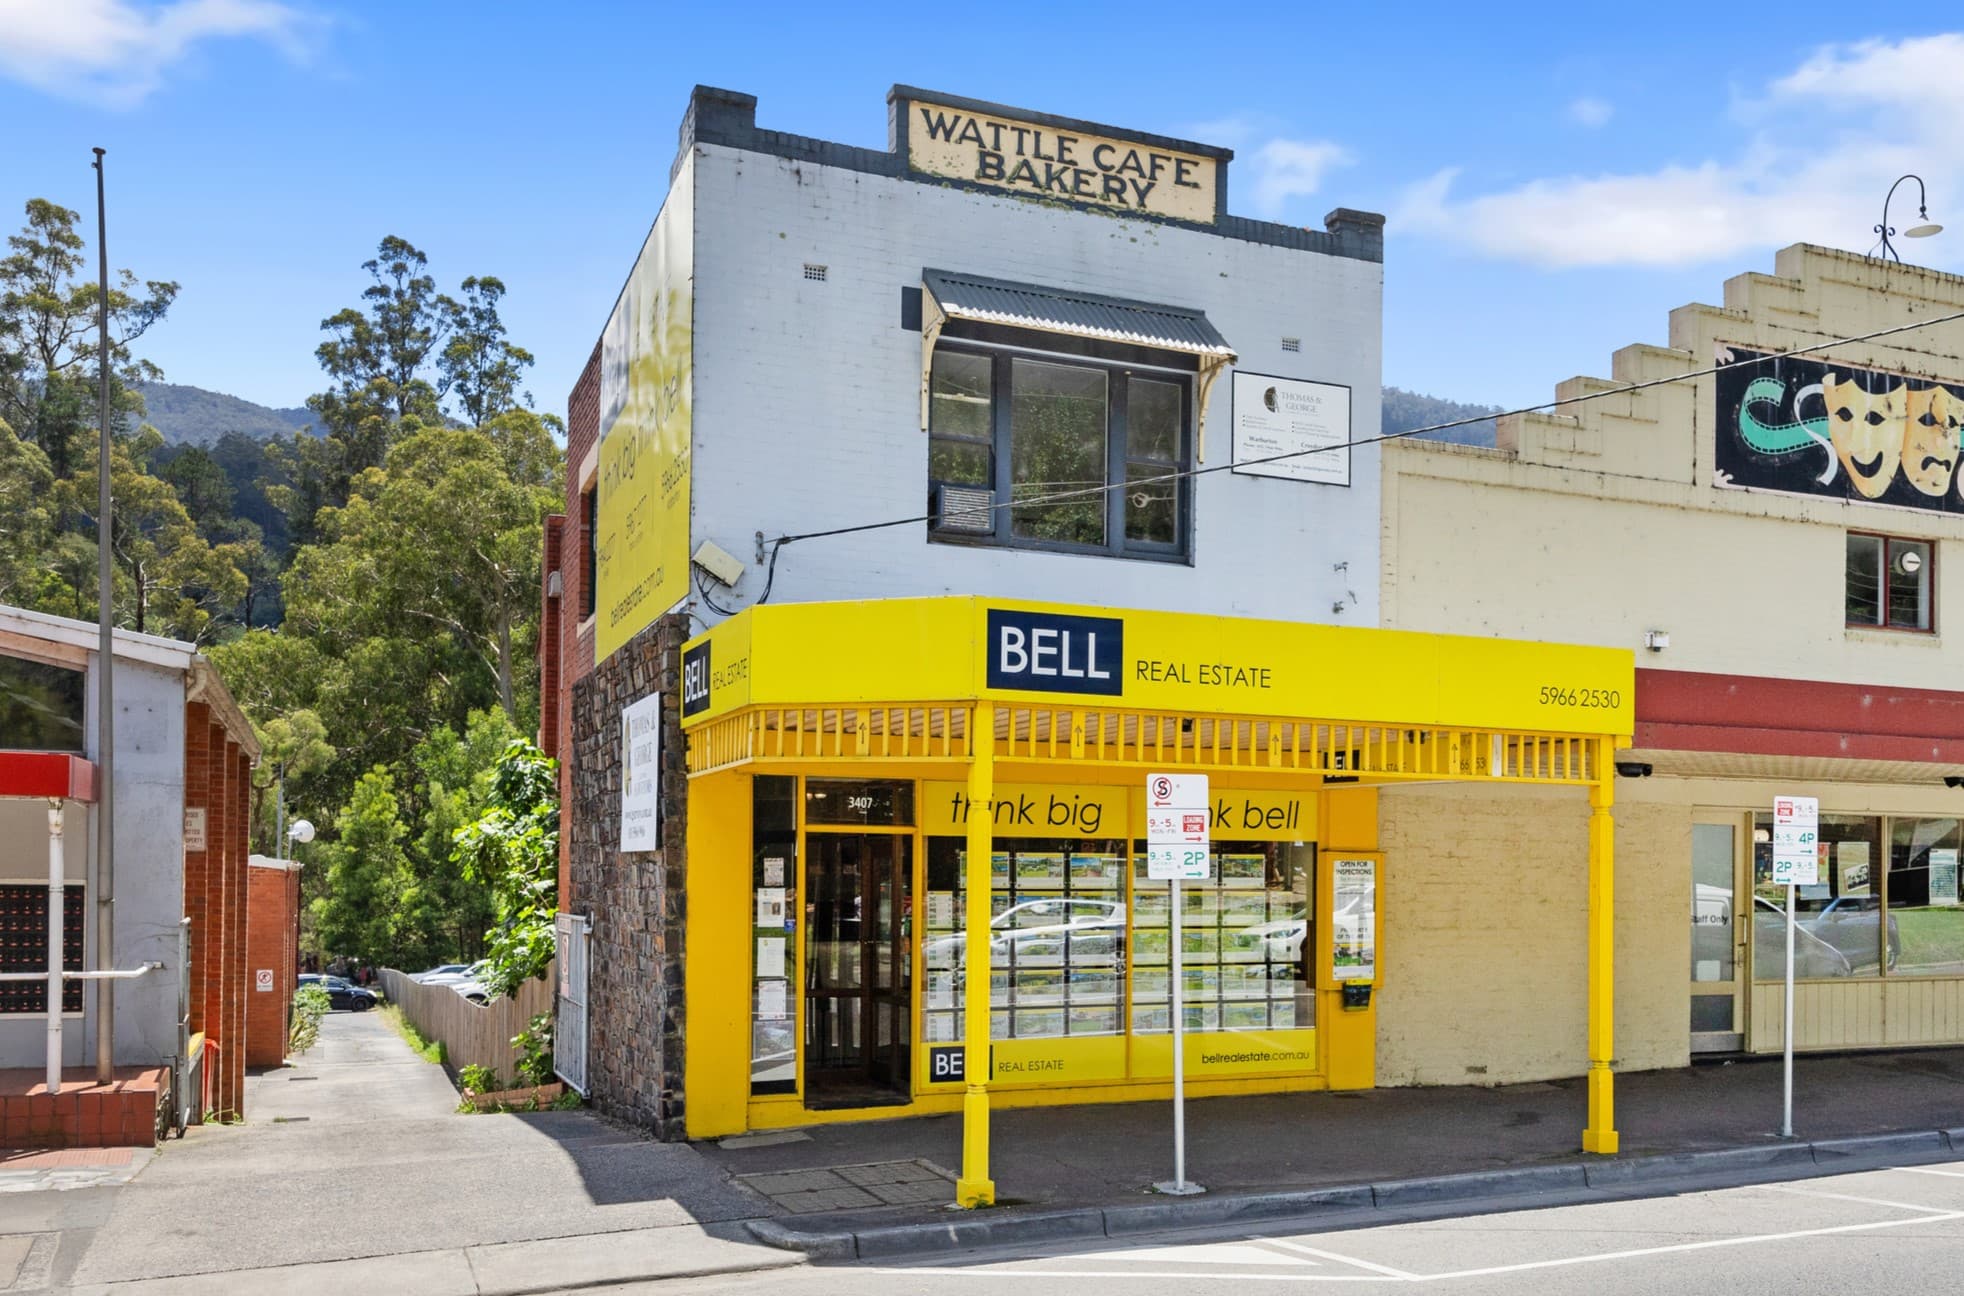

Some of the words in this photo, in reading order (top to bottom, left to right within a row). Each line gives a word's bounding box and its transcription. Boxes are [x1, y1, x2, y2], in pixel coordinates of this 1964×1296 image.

[920, 108, 1079, 167] WATTLE
[1092, 144, 1201, 189] CAFE
[977, 149, 1157, 208] BAKERY
[1281, 391, 1315, 403] THOMAS
[1285, 402, 1317, 413] GEORGE
[1000, 625, 1110, 679] BELL
[1136, 660, 1192, 684] REAL
[1199, 664, 1272, 689] ESTATE
[684, 655, 709, 704] BELL
[1539, 686, 1577, 706] 5966
[1580, 688, 1621, 709] 2530
[848, 796, 873, 809] 3407
[1047, 794, 1102, 834] big
[1243, 800, 1300, 830] bell
[1186, 824, 1201, 832] ZONE
[1798, 832, 1815, 845] 4P
[1183, 851, 1205, 866] 2P
[1775, 861, 1793, 874] 2P
[1710, 914, 1728, 926] Only
[935, 1052, 964, 1076] BE
[998, 1062, 1025, 1073] REAL
[1028, 1059, 1064, 1072] ESTATE
[1201, 1051, 1310, 1064] bellrealestate.com.au
